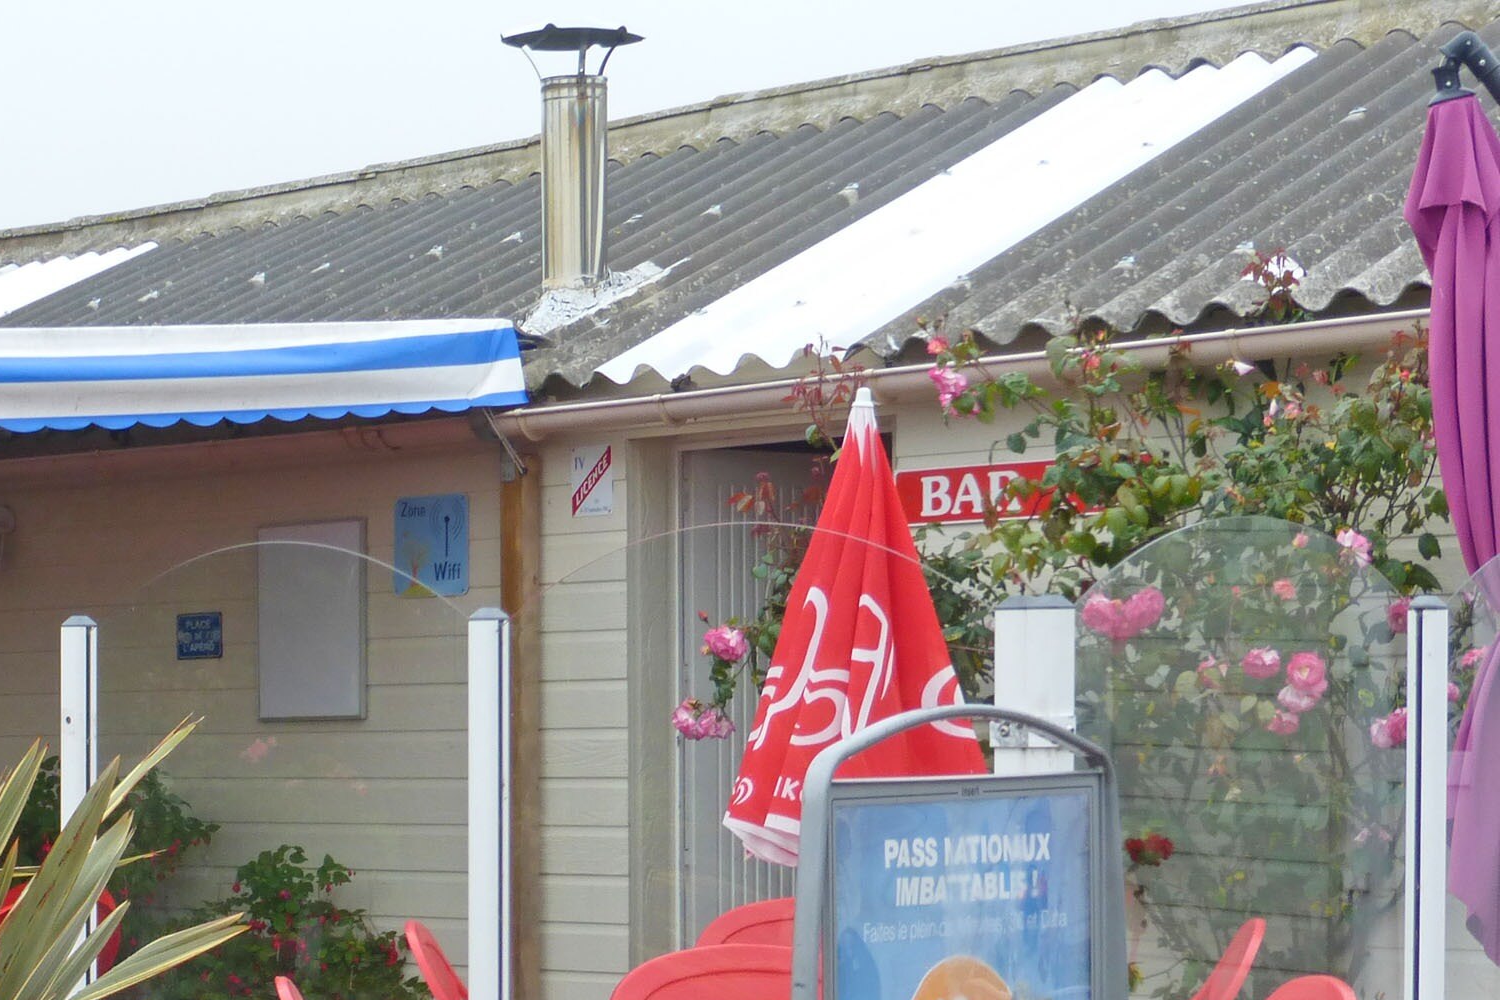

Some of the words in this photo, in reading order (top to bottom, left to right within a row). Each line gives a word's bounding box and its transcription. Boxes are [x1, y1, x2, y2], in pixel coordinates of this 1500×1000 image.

[575, 453, 608, 506] LICENCE
[400, 502, 426, 518] Zone
[434, 561, 461, 581] Wifi
[884, 838, 938, 868] PASS
